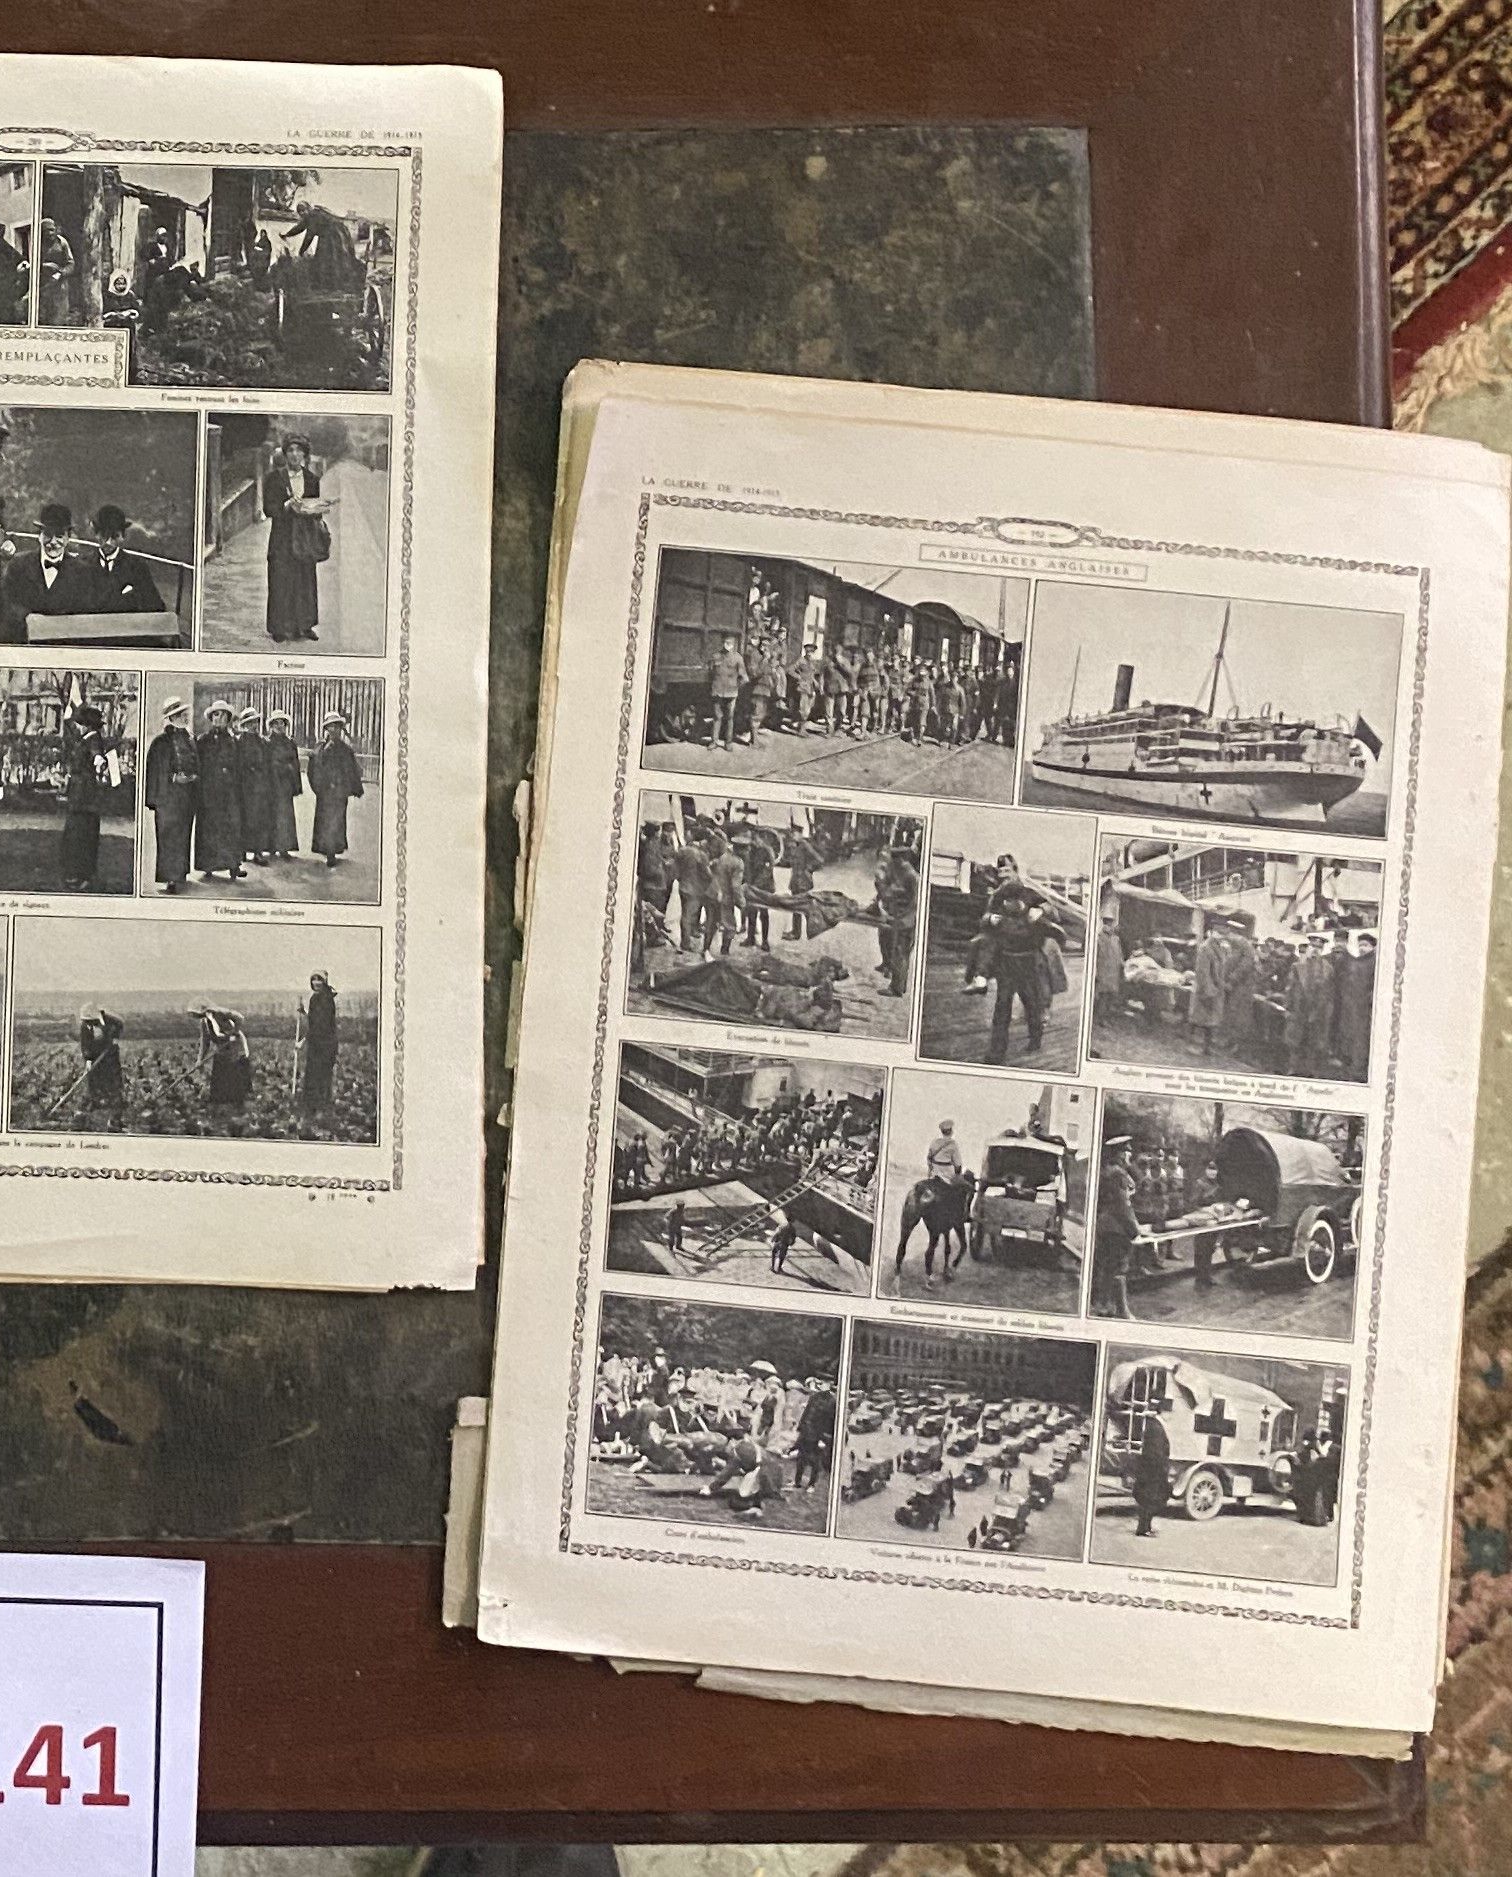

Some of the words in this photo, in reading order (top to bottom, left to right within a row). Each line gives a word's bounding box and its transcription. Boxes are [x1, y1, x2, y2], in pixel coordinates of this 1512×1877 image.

[287, 130, 301, 138] LA
[309, 130, 352, 139] GUERRE
[360, 131, 375, 139] DE
[642, 476, 656, 486] LA
[664, 477, 708, 491] GUERRE
[718, 483, 732, 494] DE
[938, 549, 1038, 568] AMBULANCES
[1044, 560, 1130, 577] ANGLAISES
